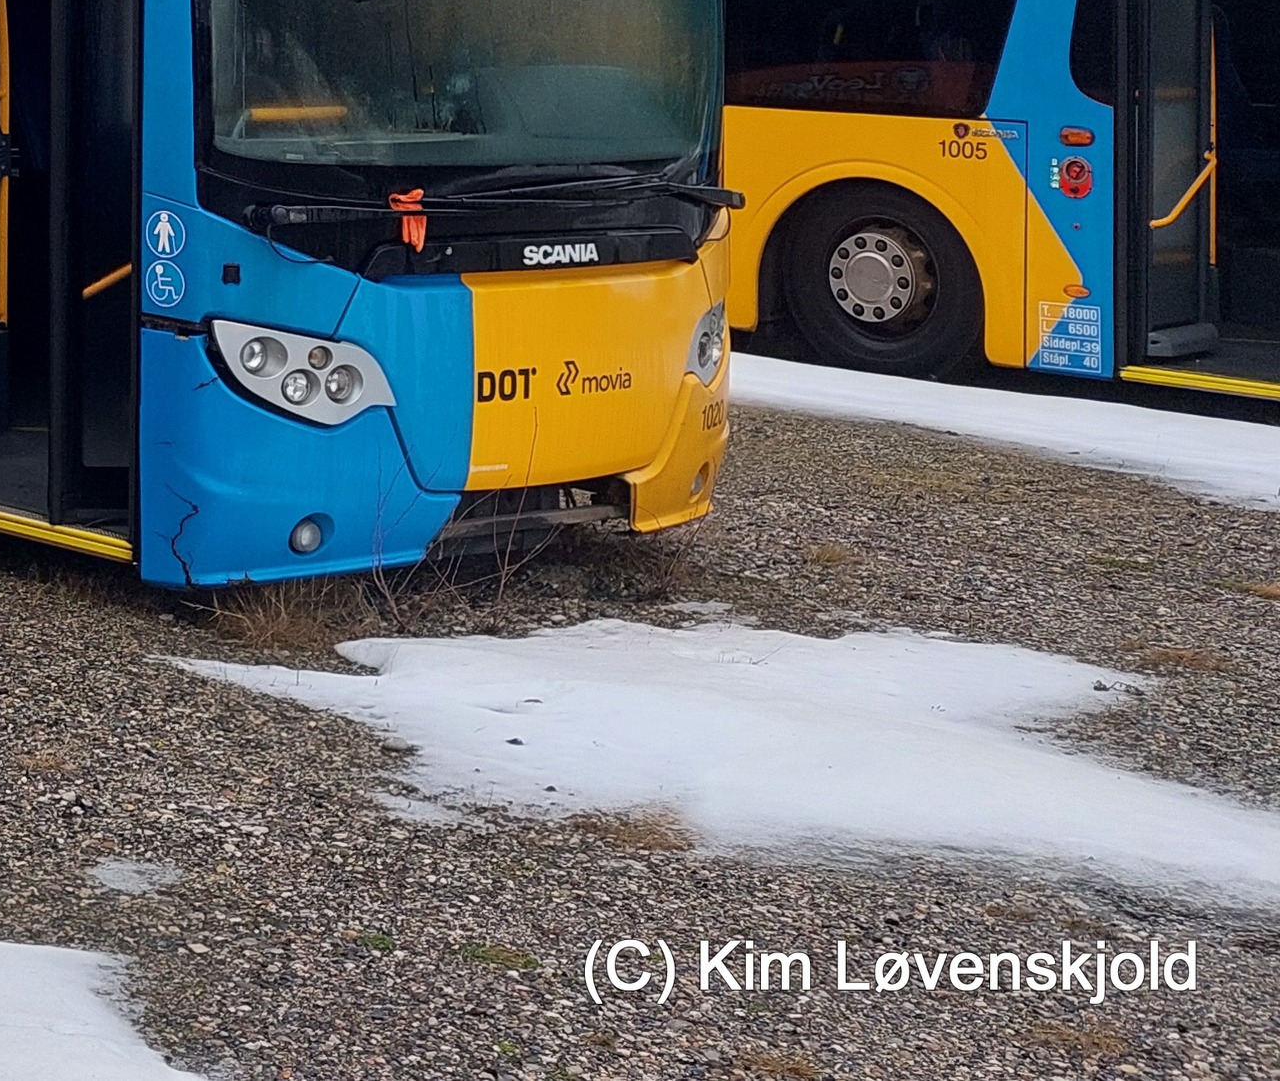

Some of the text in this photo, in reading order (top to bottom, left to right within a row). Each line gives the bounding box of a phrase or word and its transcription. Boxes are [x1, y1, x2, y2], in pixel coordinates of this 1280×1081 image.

[938, 139, 988, 160] 1005
[522, 243, 599, 266] SCANIA
[1062, 307, 1097, 321] 18000
[1068, 323, 1098, 337] 6500
[1083, 356, 1098, 368] 40
[477, 367, 537, 403] DOT
[581, 366, 632, 394] movia
[702, 398, 724, 431] 1020
